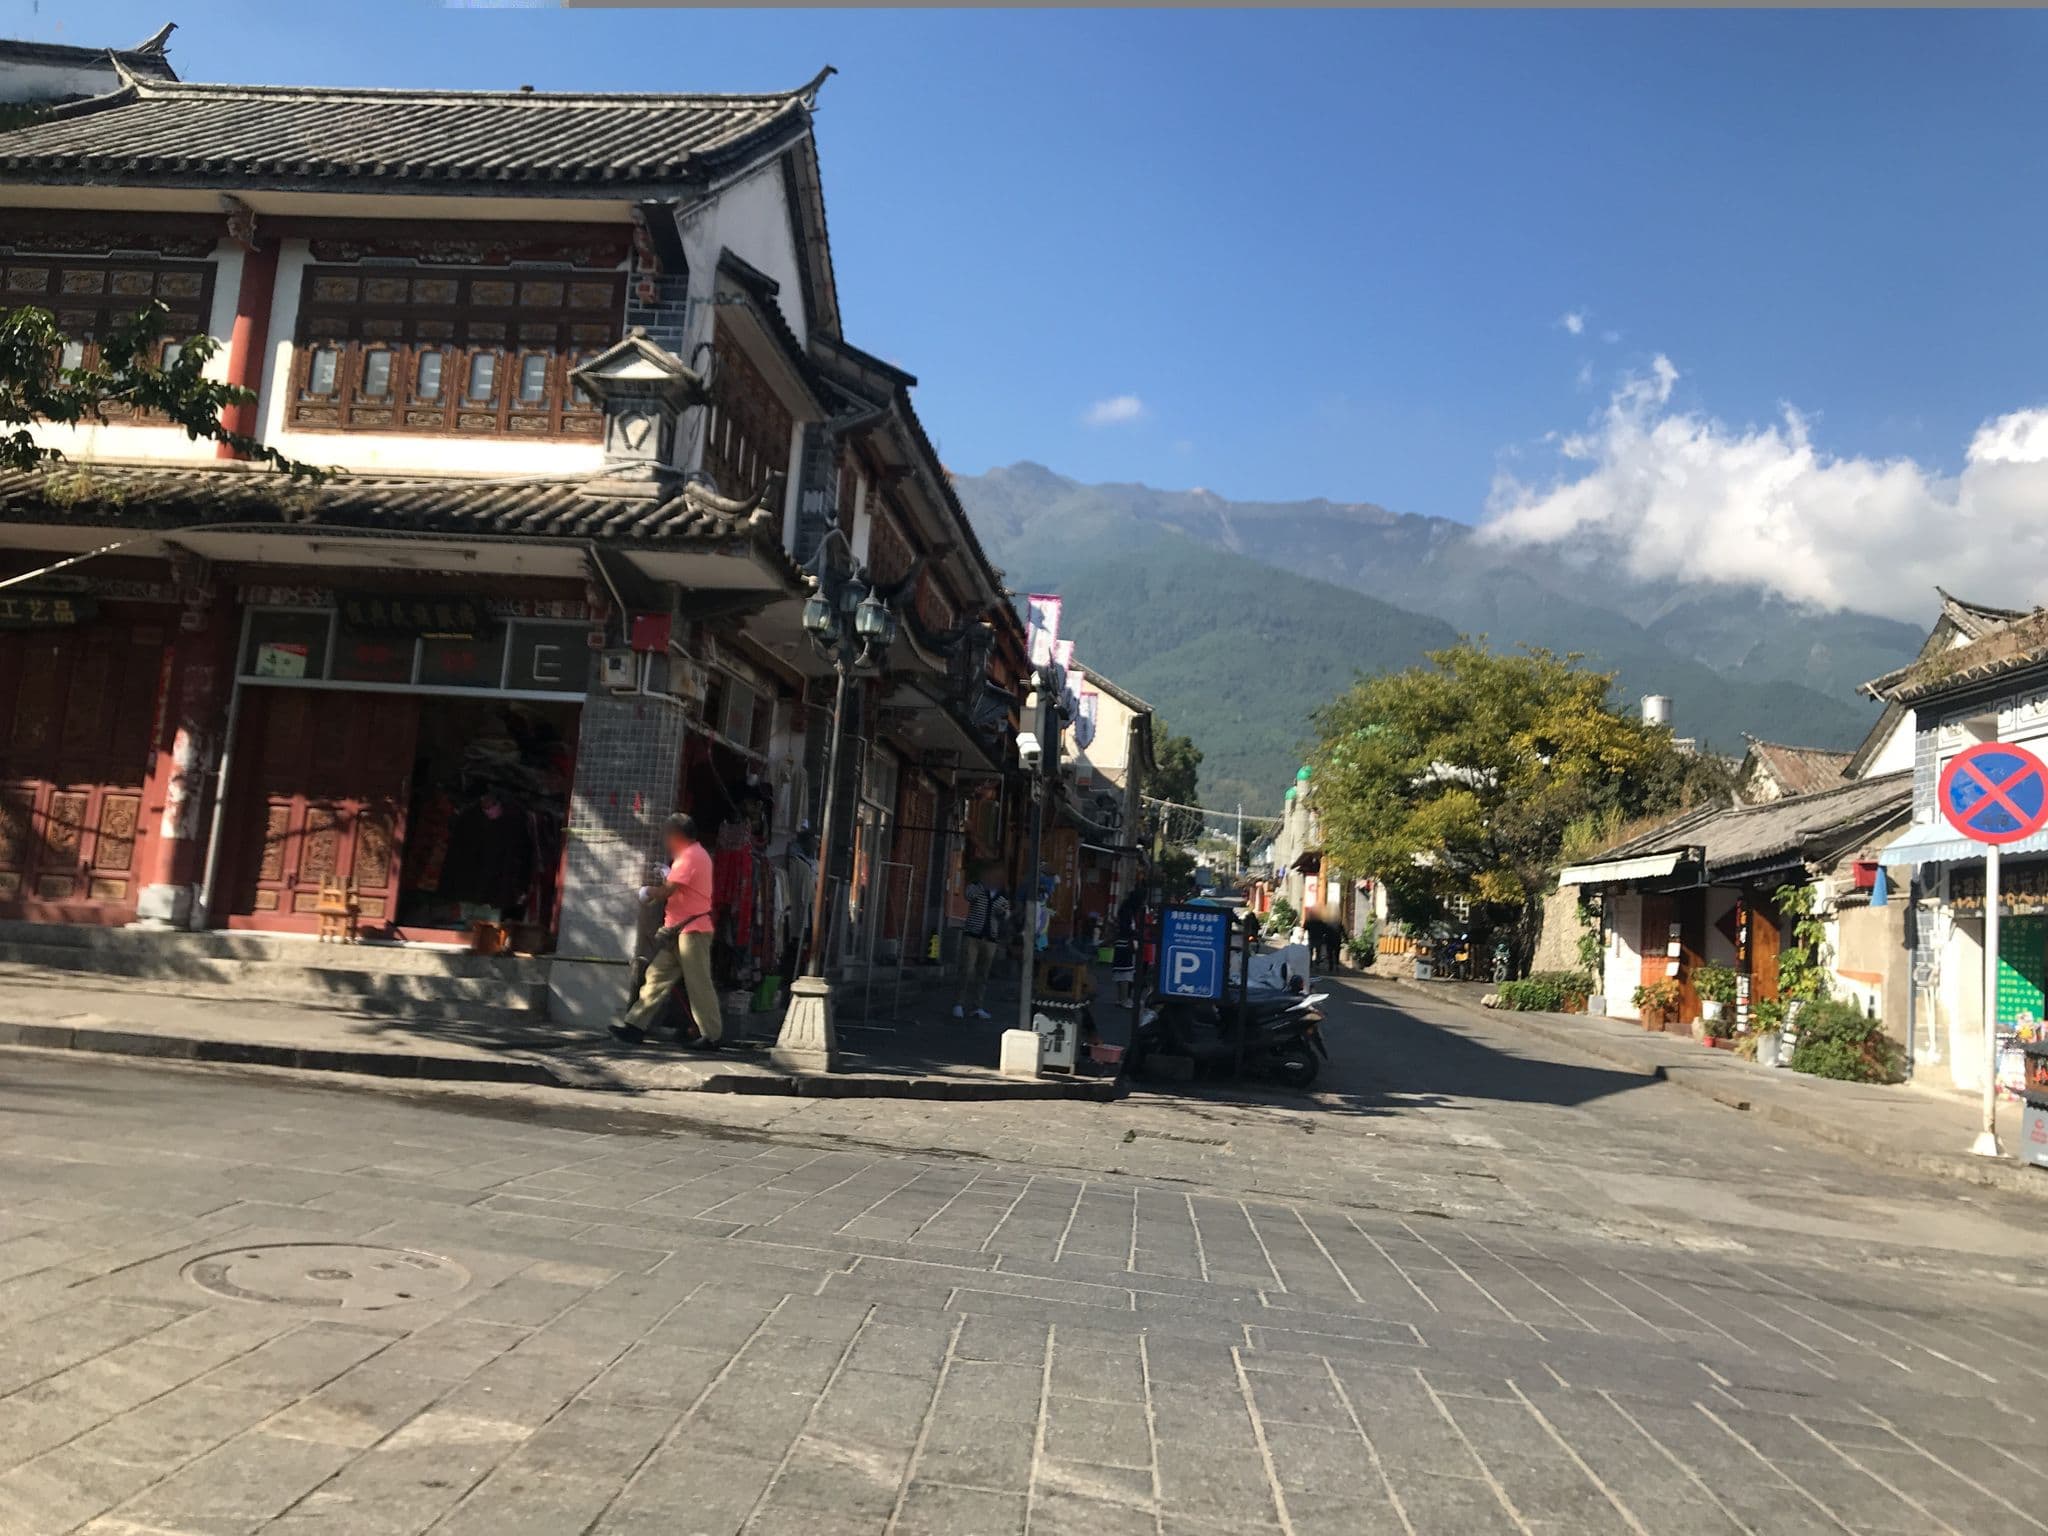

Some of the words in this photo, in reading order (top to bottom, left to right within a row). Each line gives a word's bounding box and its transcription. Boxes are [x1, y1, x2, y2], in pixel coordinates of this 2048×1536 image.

[0, 599, 76, 624] 工艺品
[1174, 951, 1200, 984] P
